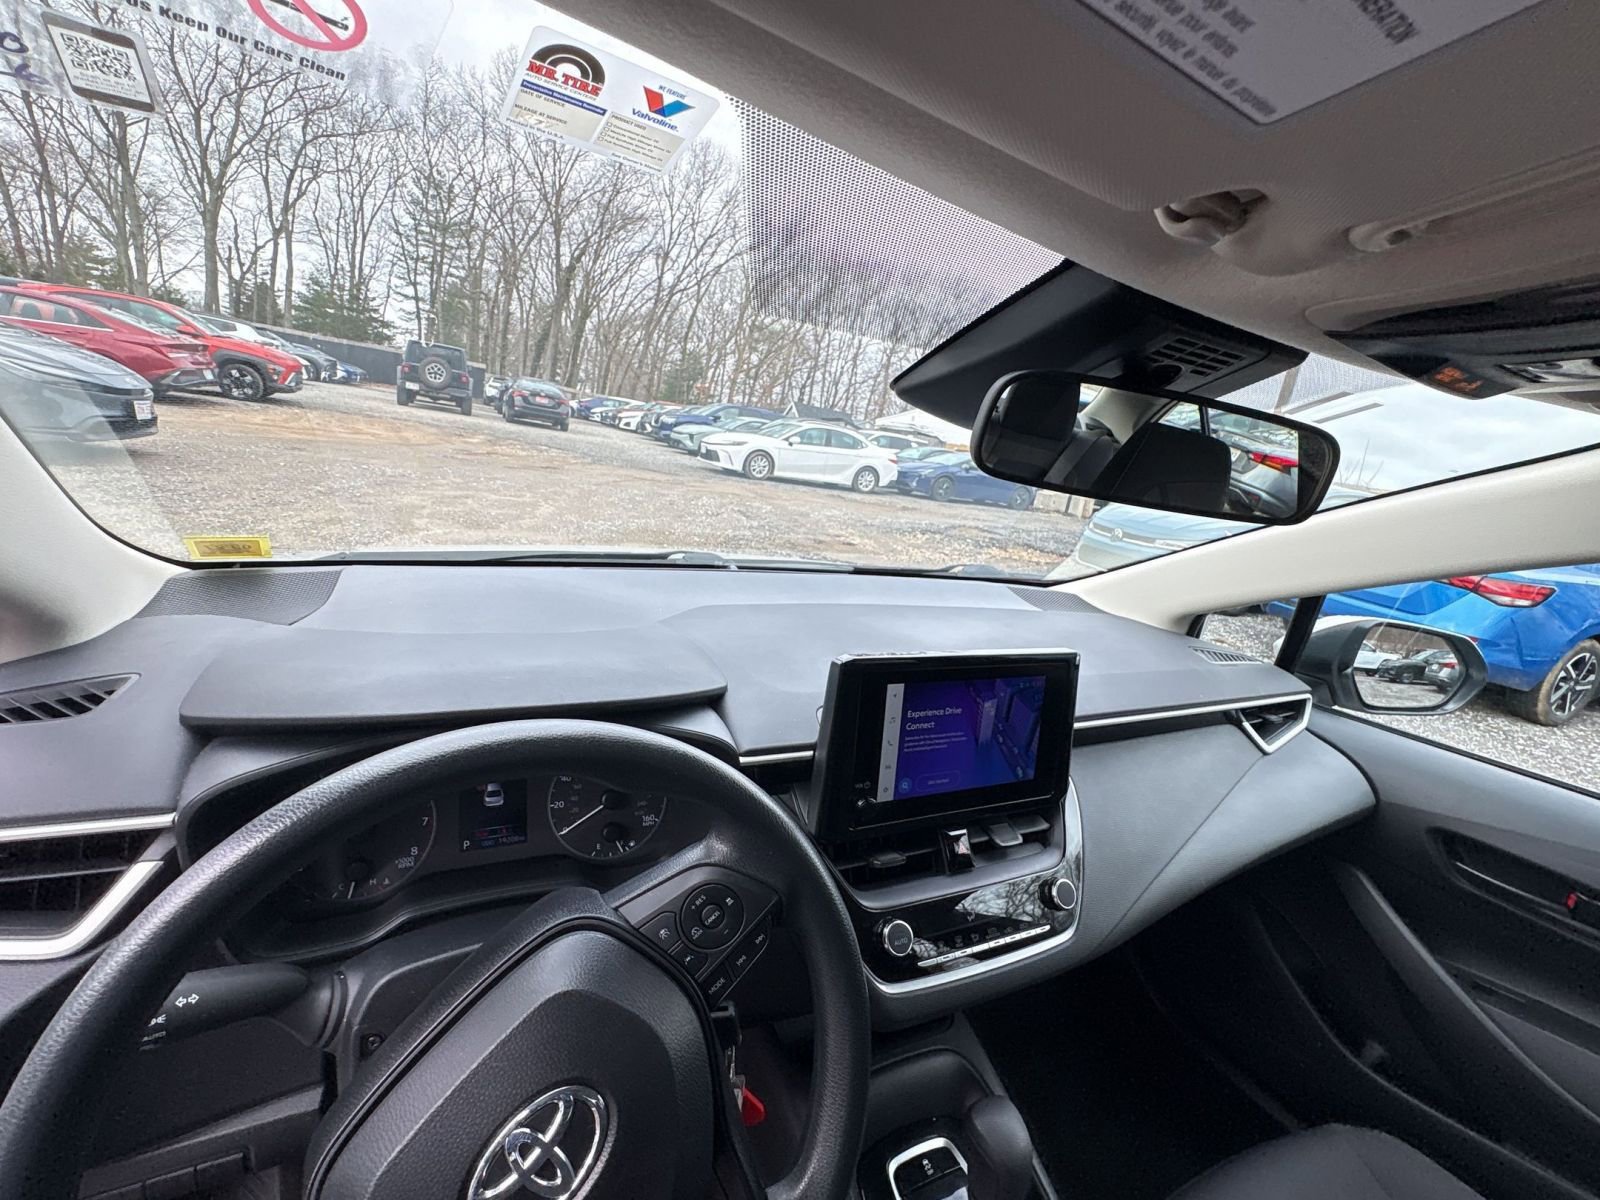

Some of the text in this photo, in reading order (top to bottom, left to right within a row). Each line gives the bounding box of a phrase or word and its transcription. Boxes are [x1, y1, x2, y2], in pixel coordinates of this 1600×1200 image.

[159, 5, 209, 32] Keep
[215, 26, 248, 45] Our
[253, 39, 294, 62] Cars
[299, 56, 346, 81] Clean
[526, 72, 542, 82] AUTO
[543, 79, 569, 91] SERVICE
[527, 60, 603, 97] MR. TIRE
[632, 108, 677, 131] Valvoline
[907, 706, 963, 718] Experience Drive
[906, 721, 935, 731] Connect
[422, 817, 429, 826] 7
[641, 814, 655, 822] 160
[410, 846, 418, 856] 8
[463, 840, 471, 850] P
[708, 977, 726, 995] MODE
